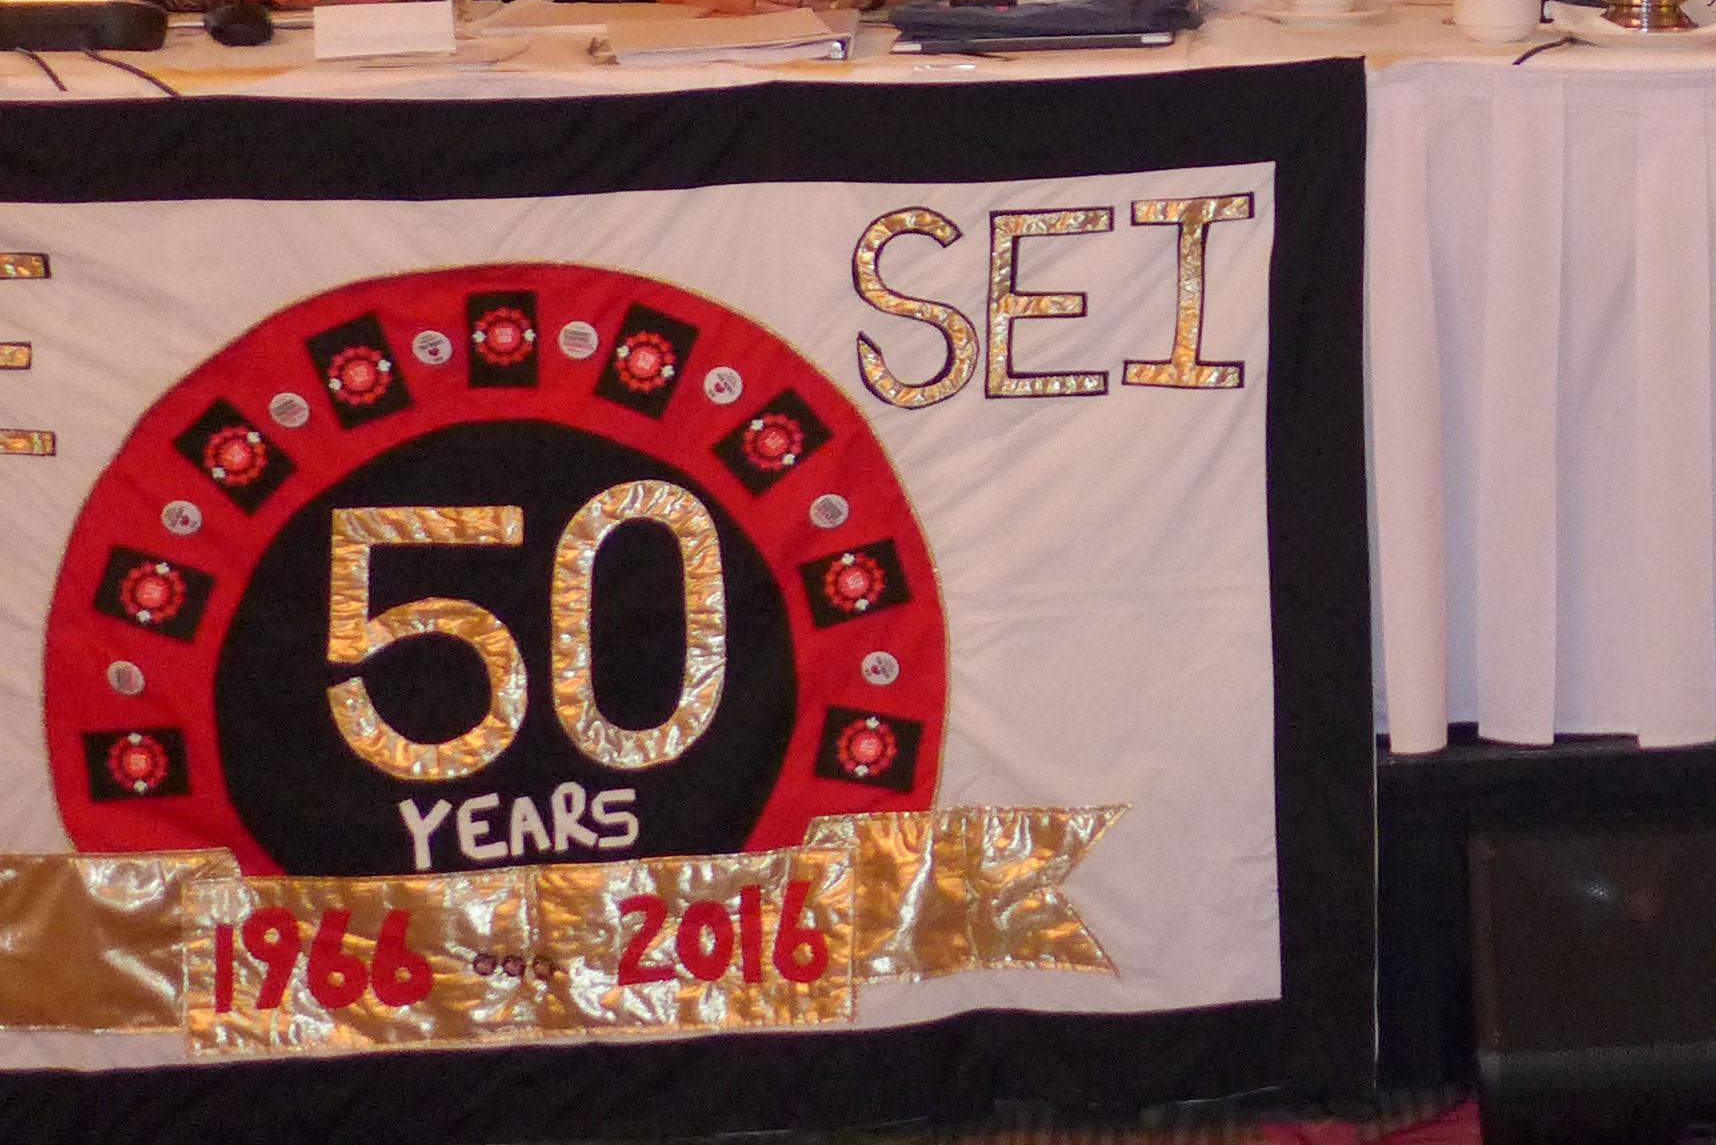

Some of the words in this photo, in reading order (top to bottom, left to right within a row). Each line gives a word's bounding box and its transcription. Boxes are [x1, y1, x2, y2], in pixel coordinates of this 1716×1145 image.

[852, 192, 1254, 409] SEI
[327, 480, 727, 782] 50
[399, 782, 639, 870] YEARS
[214, 907, 433, 1013] 1966
[617, 880, 828, 985] 2016
